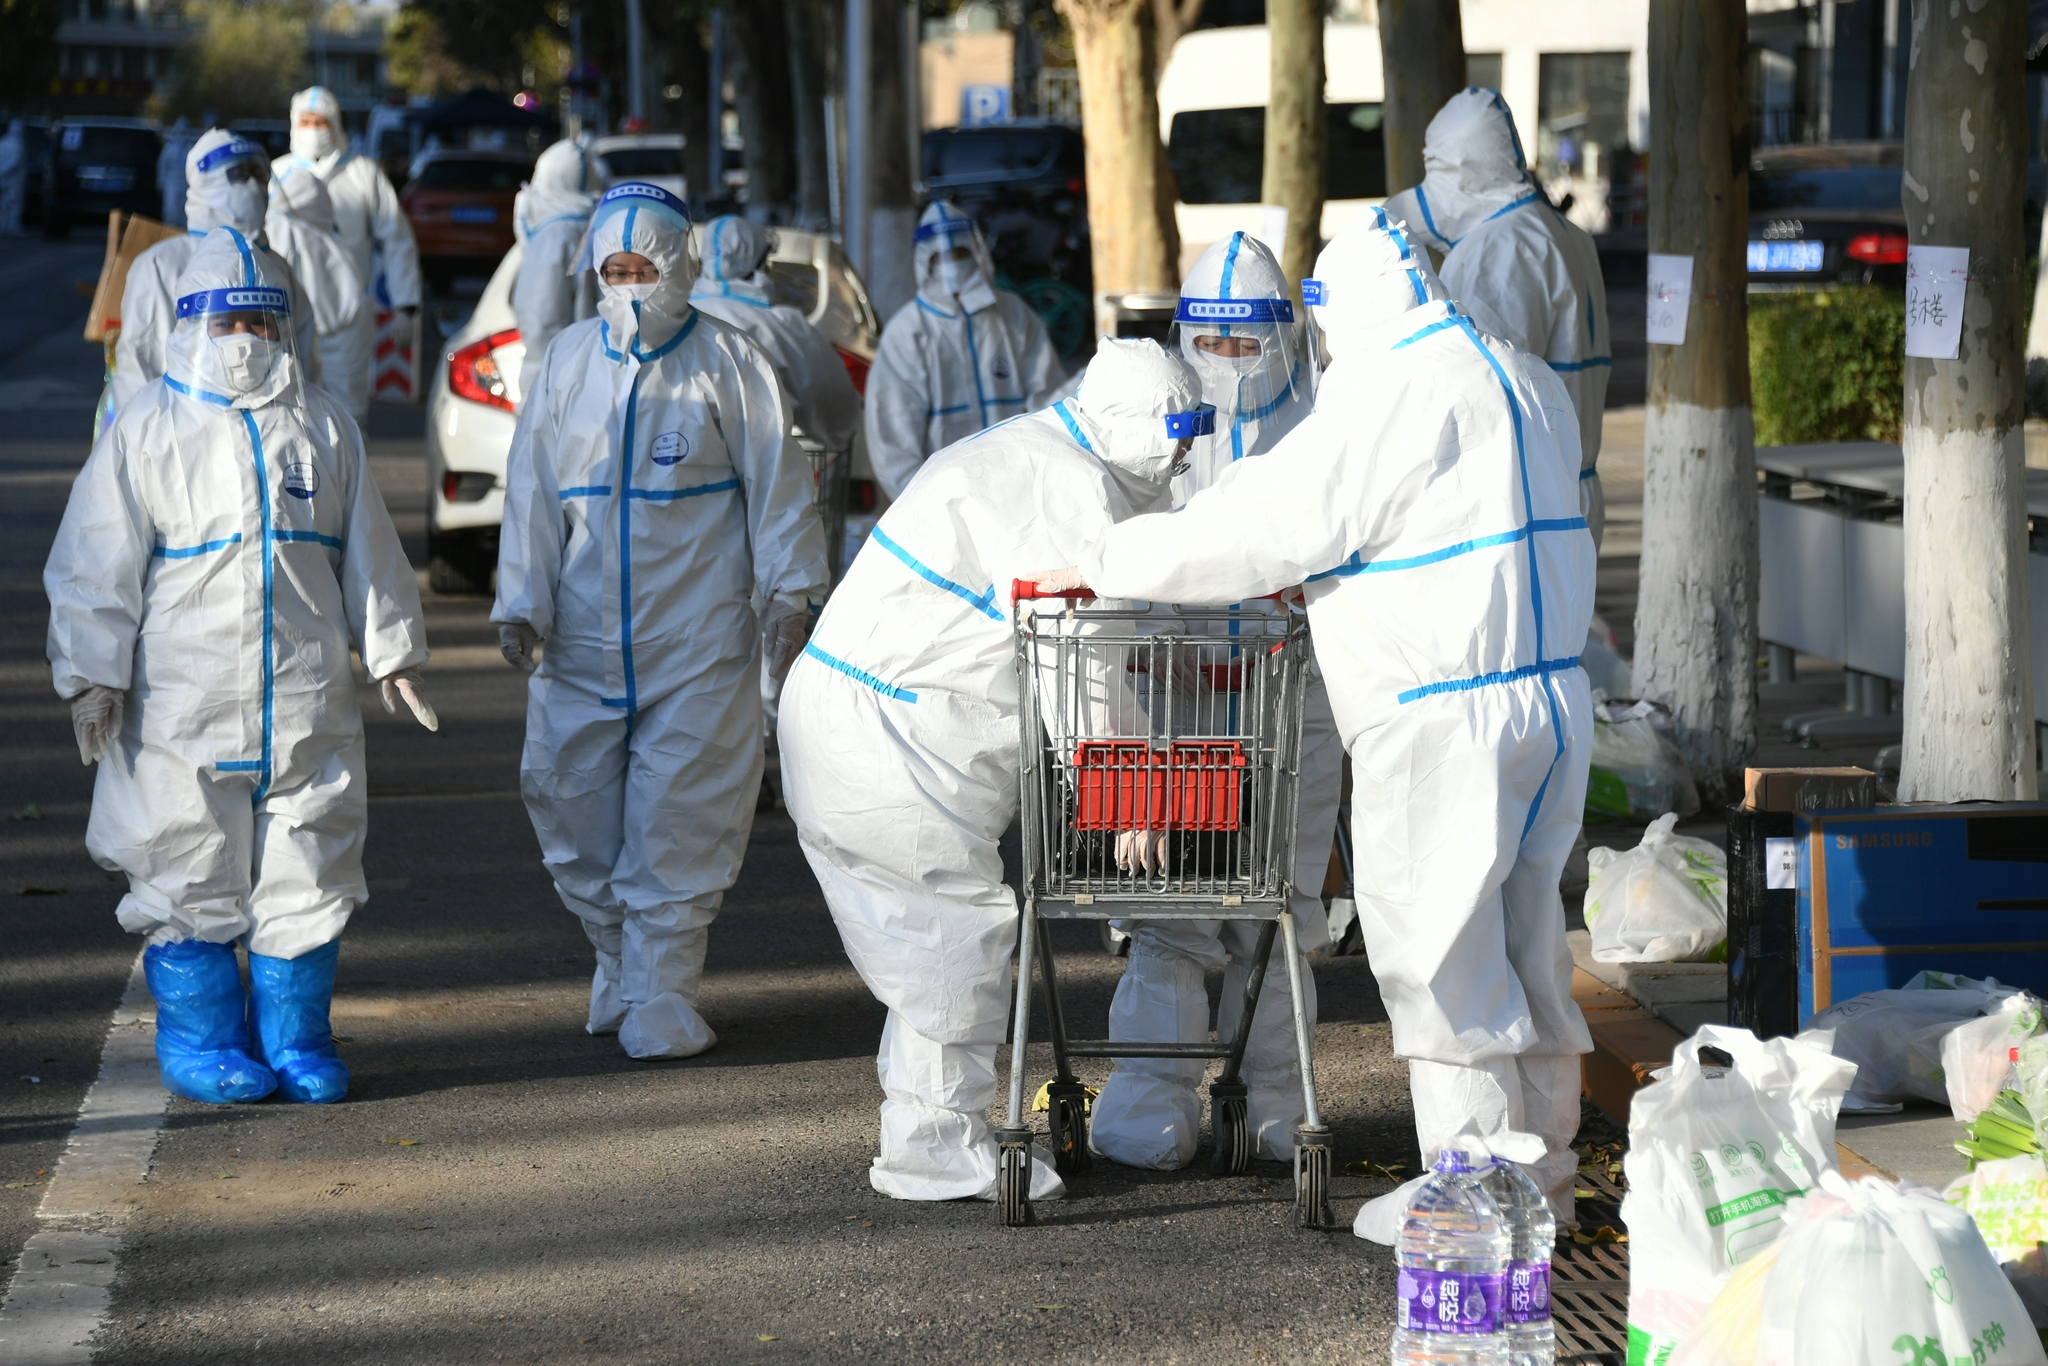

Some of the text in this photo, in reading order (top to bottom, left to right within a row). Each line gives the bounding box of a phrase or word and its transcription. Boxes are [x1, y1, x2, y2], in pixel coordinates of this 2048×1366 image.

[1192, 304, 1247, 315] 医用隔离面罩
[1836, 831, 1933, 850] SAMSUNG
[1439, 1279, 1461, 1323] 纯悦
[1511, 1269, 1531, 1312] 纯悦
